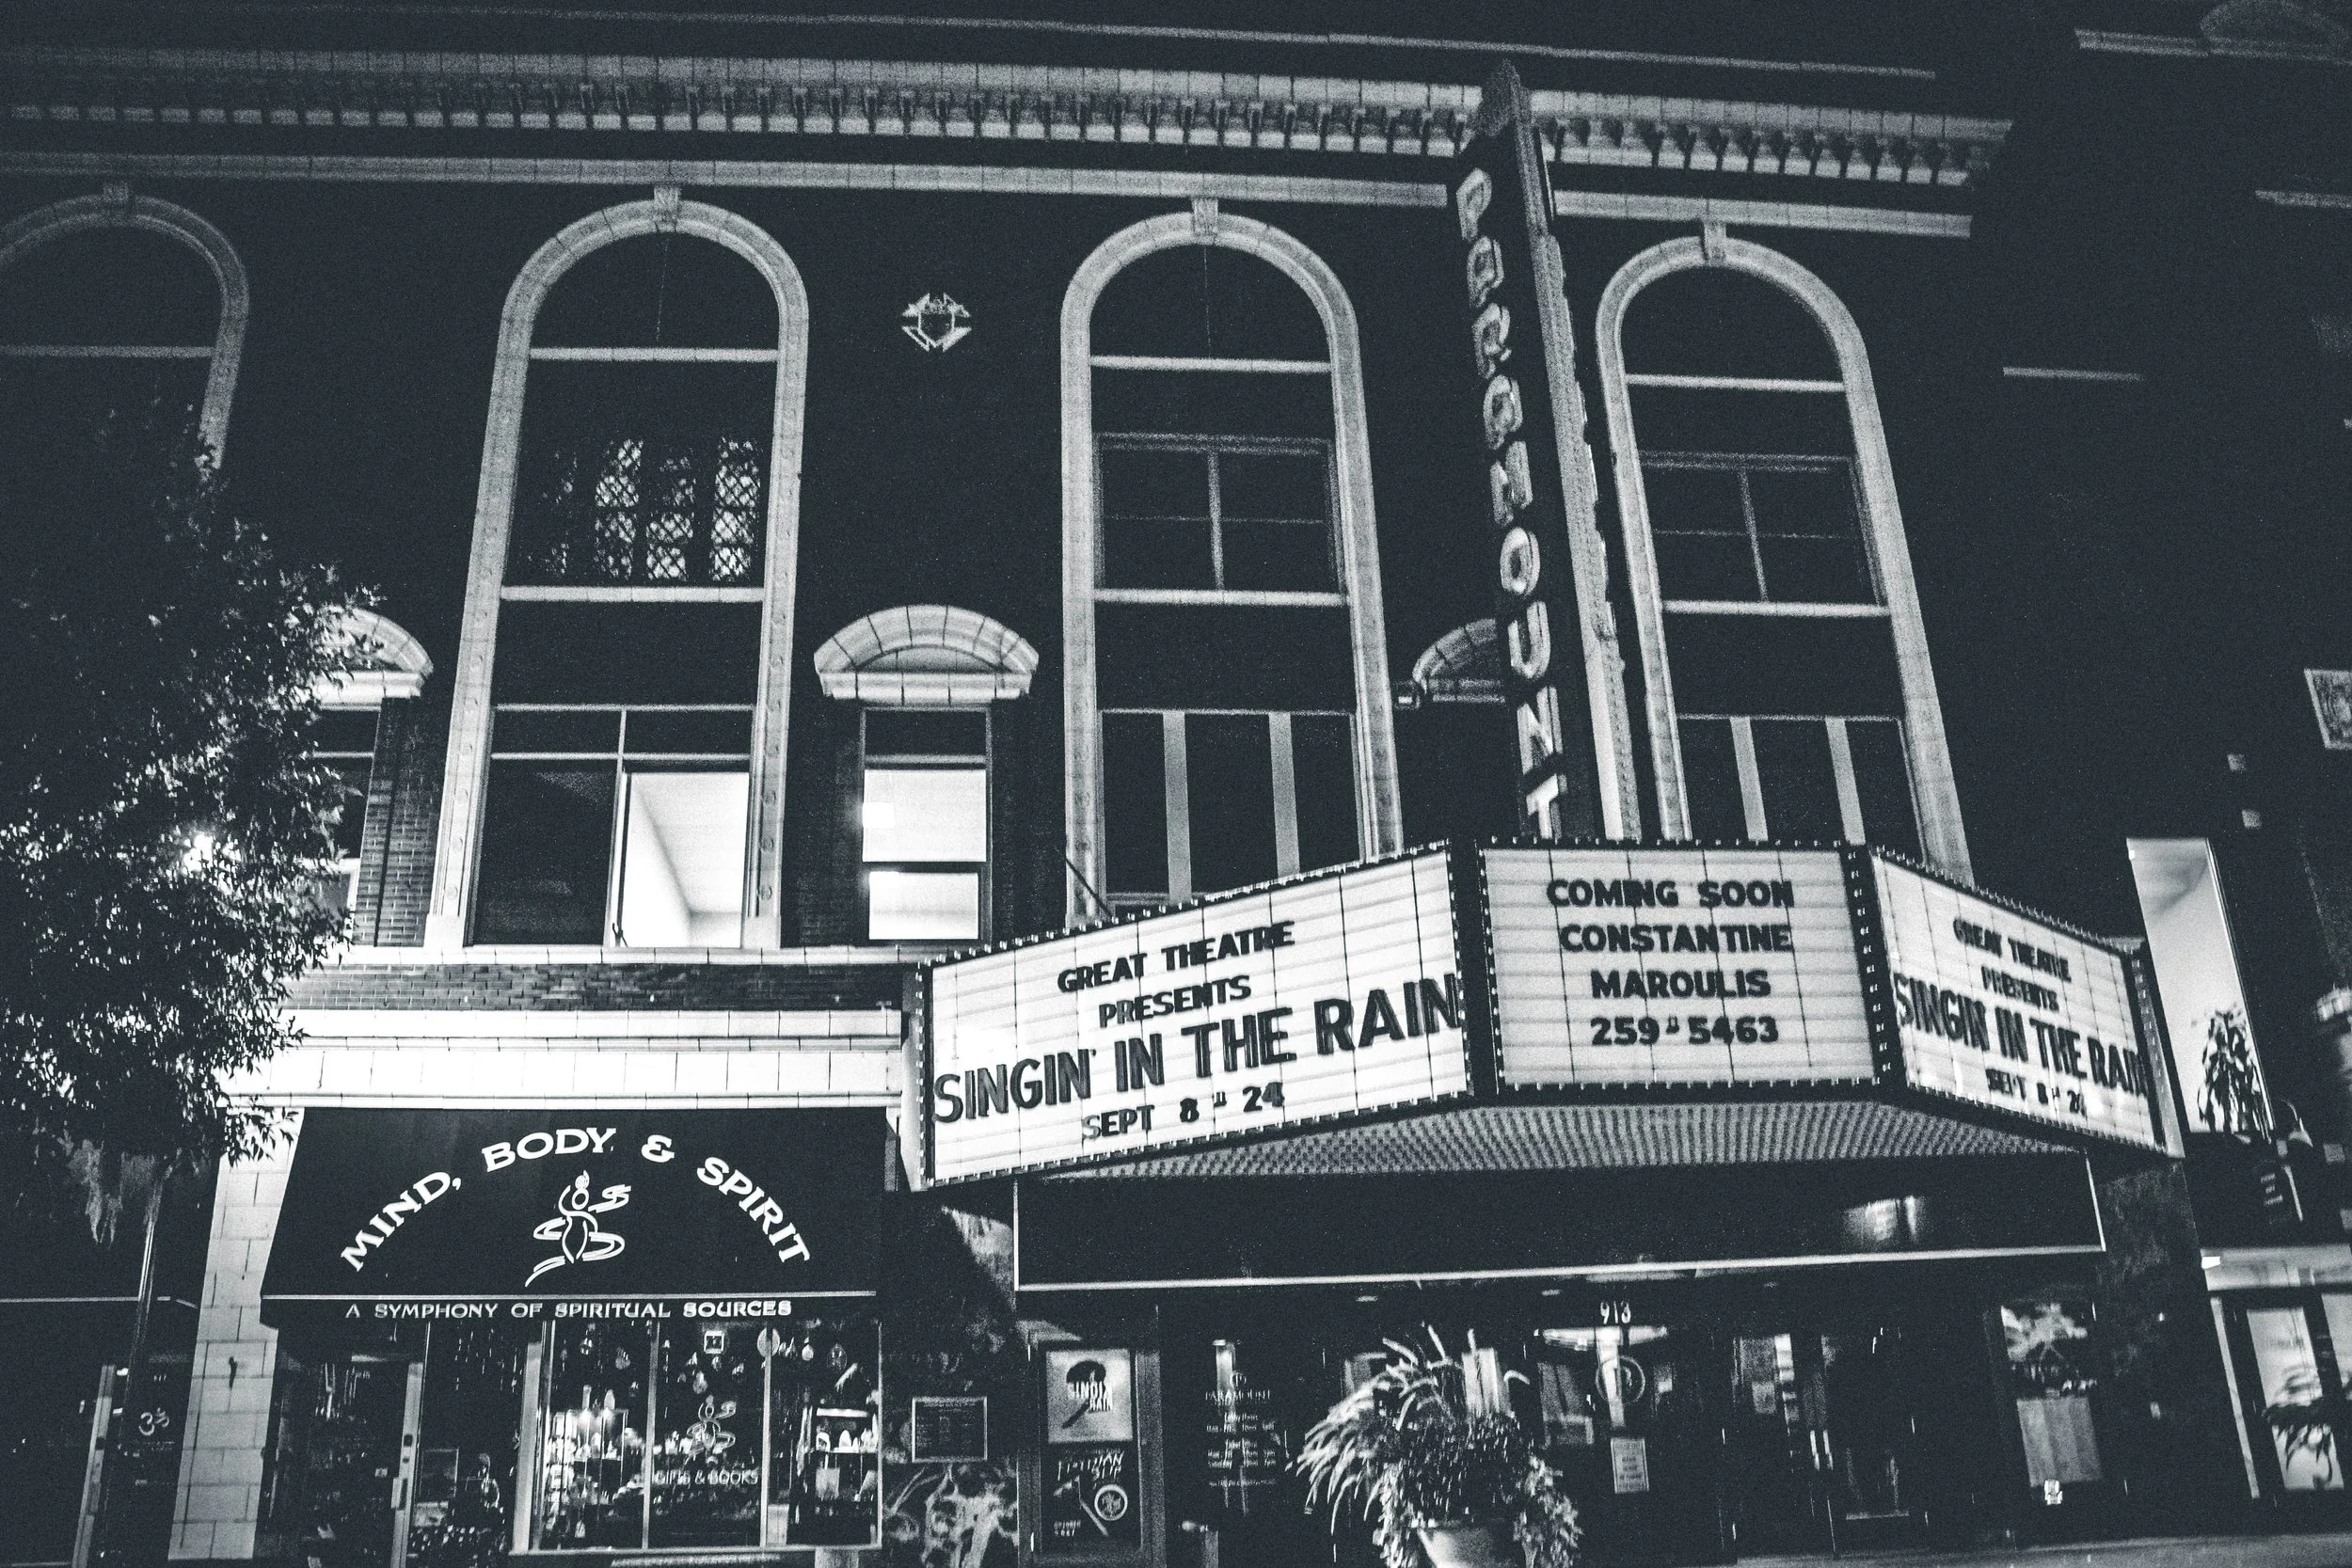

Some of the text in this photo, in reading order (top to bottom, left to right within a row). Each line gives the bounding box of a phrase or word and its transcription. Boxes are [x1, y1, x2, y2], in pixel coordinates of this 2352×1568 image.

[1546, 878, 1794, 908] COMING SOON
[1057, 920, 1295, 993] GREAT THEATRE
[1560, 925, 1794, 953] CONSTANTINE
[1099, 974, 1251, 1028] PRESENTS
[1591, 970, 1772, 1000] MAROULIS
[1981, 966, 2059, 1013] PRESENTS
[932, 973, 1460, 1124] SINGIN' IN THE RAIN
[1994, 1006, 2029, 1063] IN
[2029, 1017, 2088, 1080] THE
[2088, 1037, 2149, 1099] RAIN
[1083, 1104, 1154, 1140] SEPT
[341, 1128, 810, 1272] MIND, BODY & SPIRIT
[347, 1300, 791, 1318] A SYMPHONY OF SPIRITUAL SOURCES
